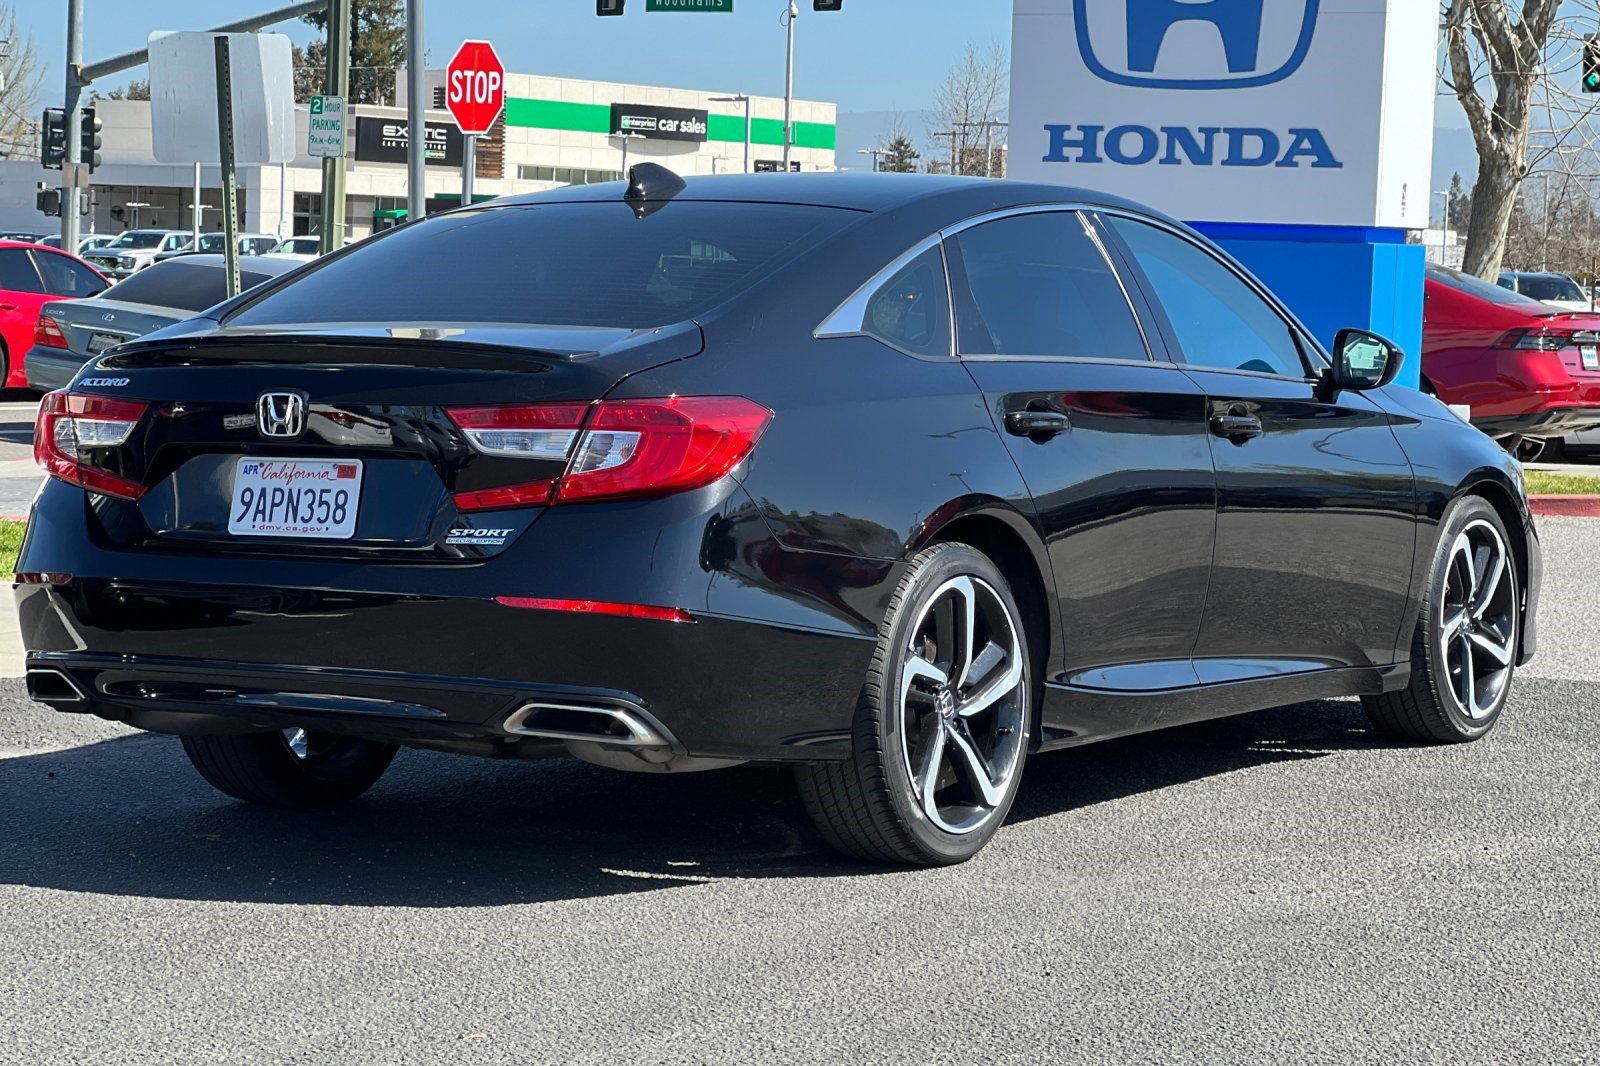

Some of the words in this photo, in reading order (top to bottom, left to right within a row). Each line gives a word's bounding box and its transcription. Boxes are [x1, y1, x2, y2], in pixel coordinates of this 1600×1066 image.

[450, 69, 501, 105] STOP
[313, 98, 321, 112] 2
[324, 103, 341, 113] HOUR
[312, 119, 340, 131] PARKING
[382, 125, 447, 140] EXTIC
[658, 119, 680, 132] car
[680, 116, 706, 134] sales
[1042, 124, 1344, 168] HONDA
[79, 378, 130, 387] ACCORD
[243, 464, 259, 476] APR
[261, 462, 337, 486] California
[236, 487, 349, 525] 9APN358
[258, 524, 322, 533] dmv.ca.gov
[448, 528, 515, 537] SPORT
